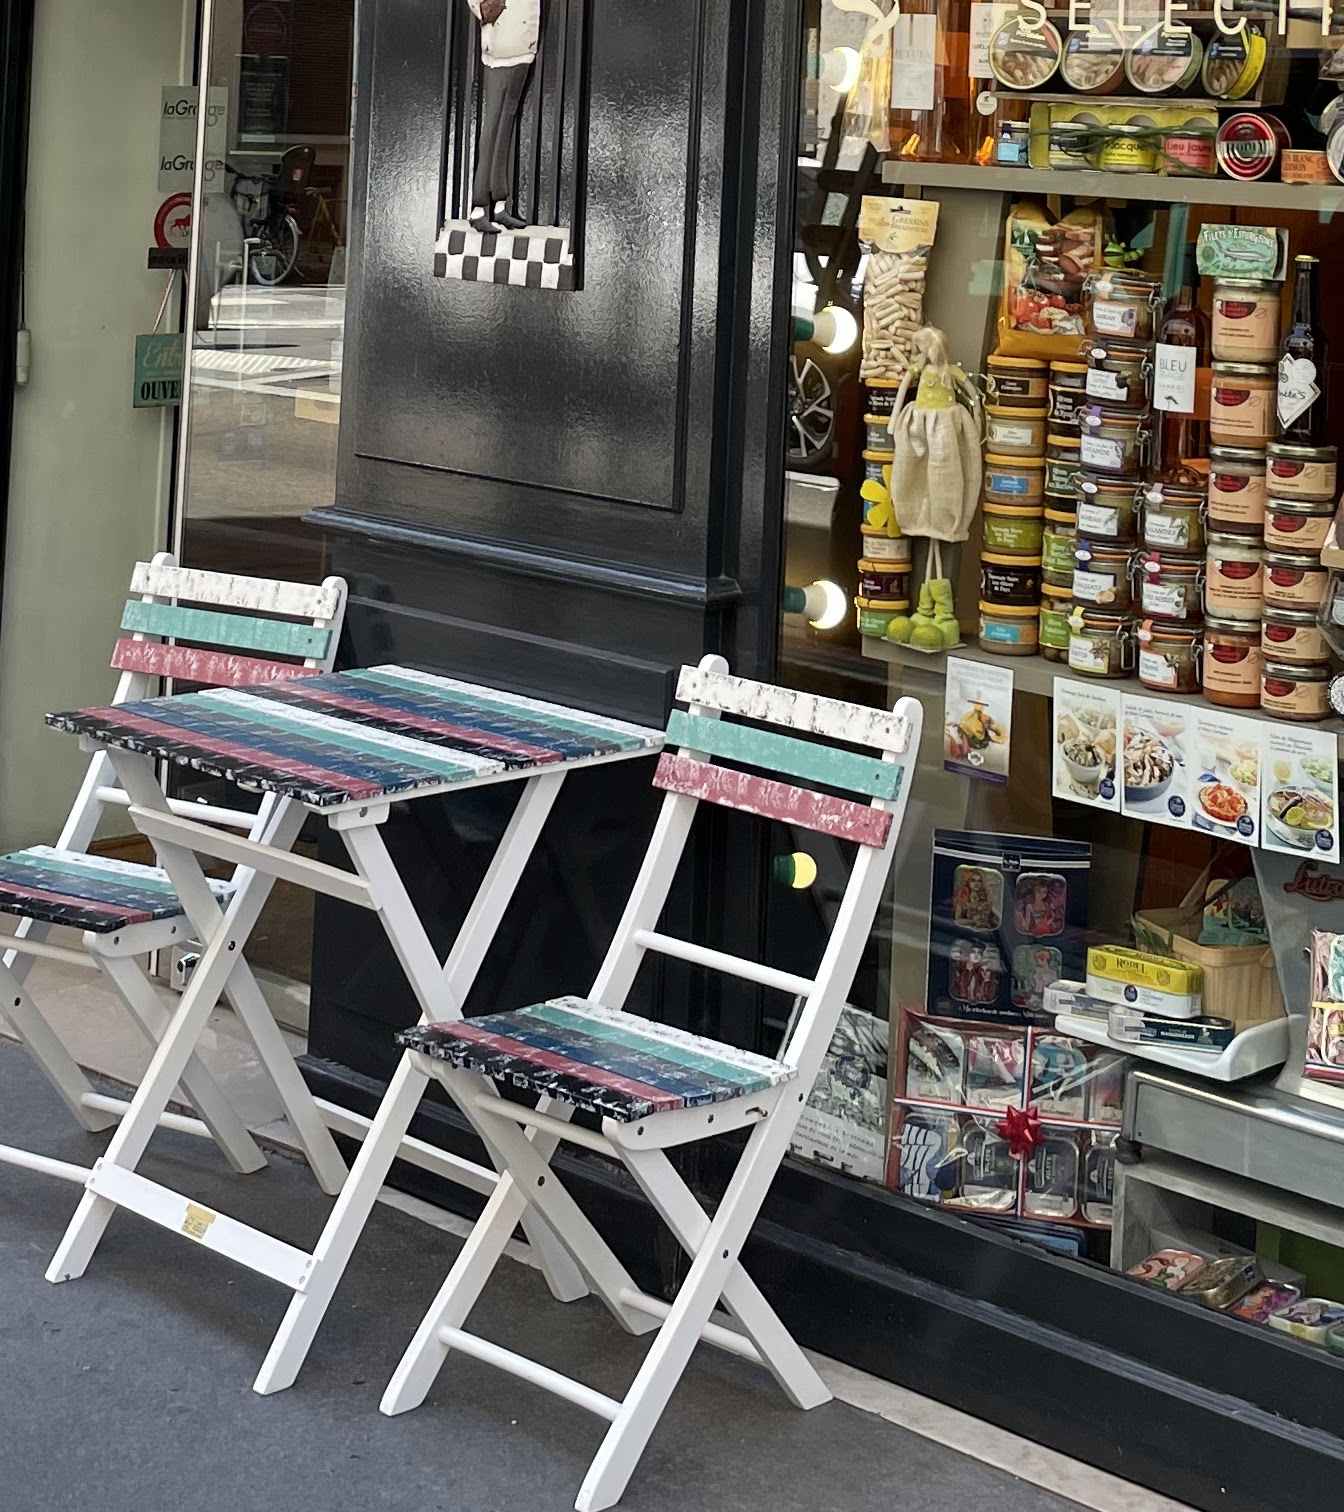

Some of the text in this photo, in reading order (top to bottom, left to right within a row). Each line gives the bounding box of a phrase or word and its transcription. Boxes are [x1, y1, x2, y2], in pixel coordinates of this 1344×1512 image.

[163, 99, 225, 127] laGrge
[160, 155, 224, 182] laGrge
[143, 340, 183, 369] Entr
[1159, 358, 1187, 373] BLEU
[141, 379, 182, 402] OUVE
